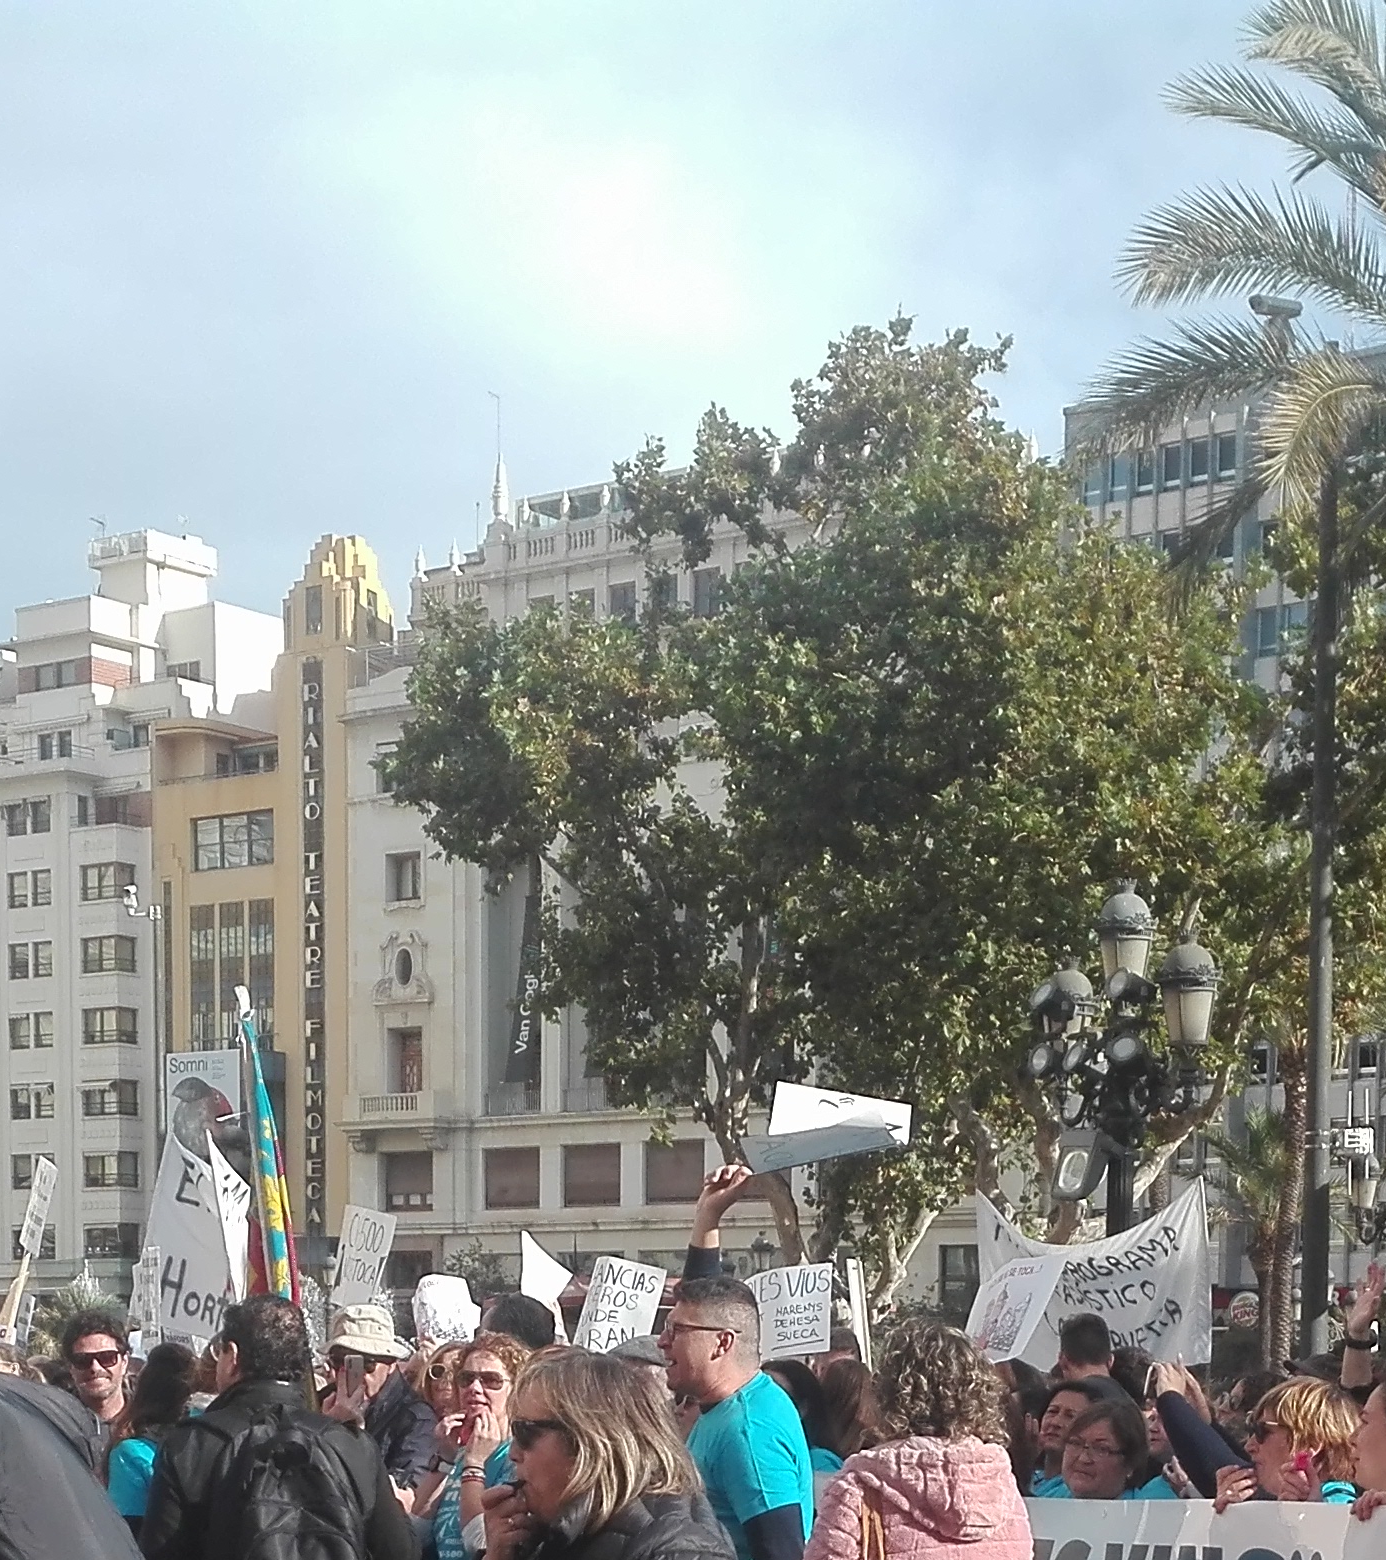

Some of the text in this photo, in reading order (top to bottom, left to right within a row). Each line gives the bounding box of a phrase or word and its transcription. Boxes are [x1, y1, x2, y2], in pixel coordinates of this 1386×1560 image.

[303, 681, 323, 1224] RIALTO TEATRE FILMOTECA
[515, 1020, 531, 1054] Van
[169, 1058, 208, 1074] Somni
